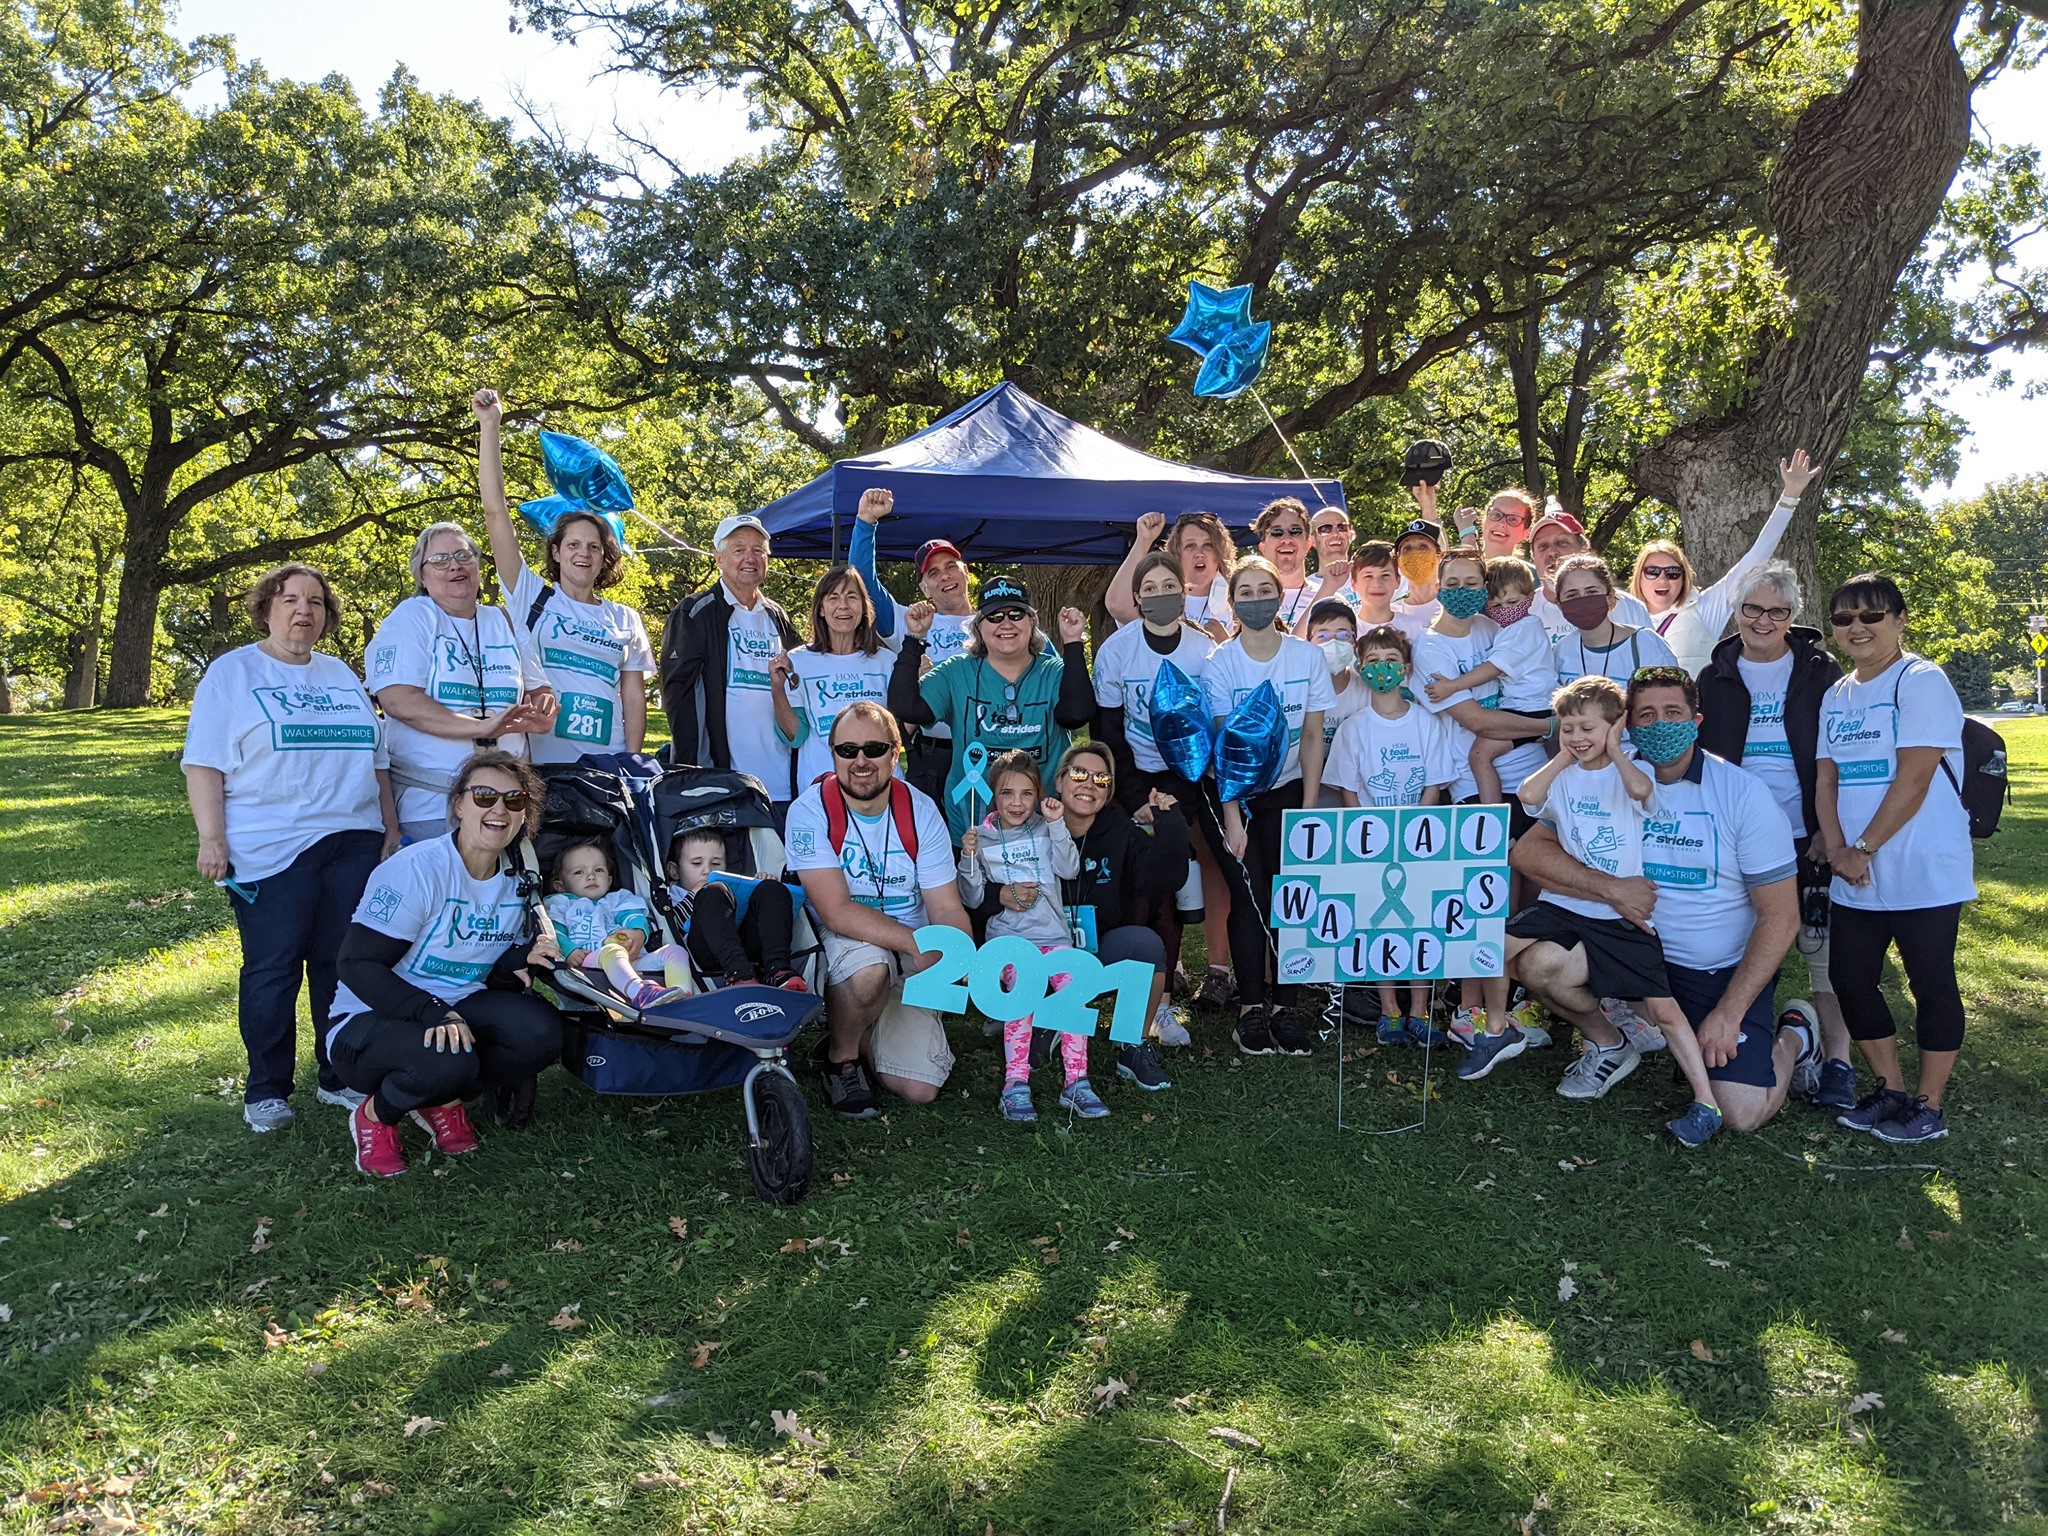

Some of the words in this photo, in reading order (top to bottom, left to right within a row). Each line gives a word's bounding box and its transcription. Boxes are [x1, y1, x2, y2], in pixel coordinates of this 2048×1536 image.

[572, 623, 607, 638] teal
[582, 634, 623, 652] strides
[744, 638, 770, 650] teal
[754, 650, 776, 658] strid
[835, 673, 860, 681] HOM
[295, 684, 323, 694] HOM
[832, 680, 864, 692] teal
[293, 692, 333, 704] teal
[845, 690, 883, 698] strides
[313, 703, 361, 712] strides
[1280, 704, 1302, 713] ides
[1750, 701, 1780, 715] eal
[1753, 714, 1784, 724] strid
[1836, 717, 1865, 732] teal
[567, 713, 602, 738] 281
[1001, 725, 1041, 734] strides
[1842, 730, 1881, 742] strides
[1390, 747, 1409, 756] teal
[1577, 801, 1599, 810] teal
[1655, 809, 1677, 819] OM
[1643, 818, 1681, 834] teal
[1301, 815, 1487, 859] TEAL
[1656, 835, 1704, 847] strides
[1011, 849, 1030, 859] teal
[369, 900, 389, 921] CA
[467, 915, 499, 931] teal
[478, 931, 515, 942] strides
[1479, 949, 1492, 960] Honor
[1285, 957, 1307, 969] Celebrate
[902, 924, 1155, 1045] 2021
